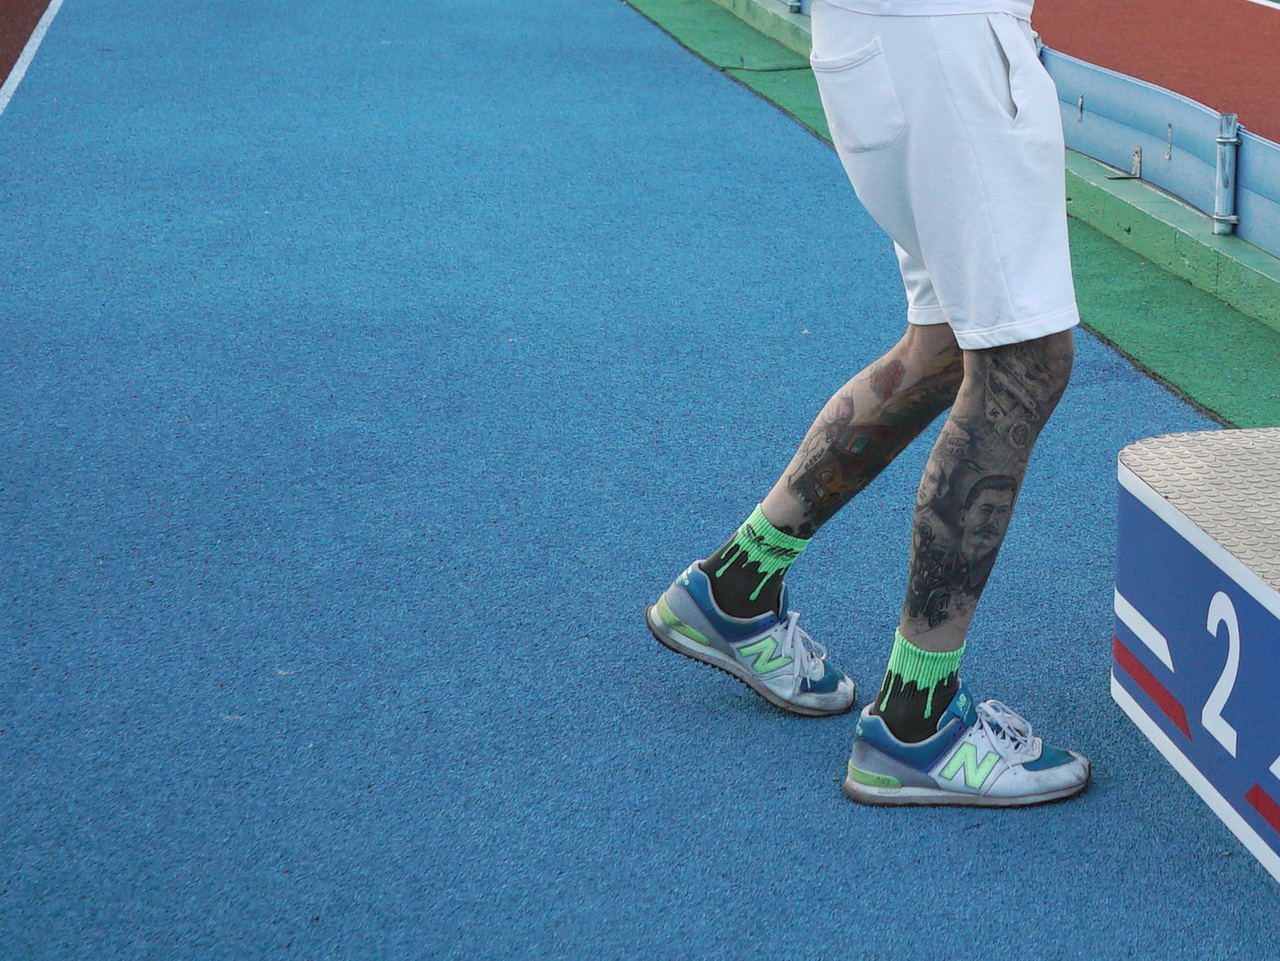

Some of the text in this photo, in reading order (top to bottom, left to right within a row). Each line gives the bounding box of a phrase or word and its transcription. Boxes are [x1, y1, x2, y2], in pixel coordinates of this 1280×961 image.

[737, 635, 793, 675] N
[1201, 590, 1241, 758] 2
[938, 741, 1001, 790] N
